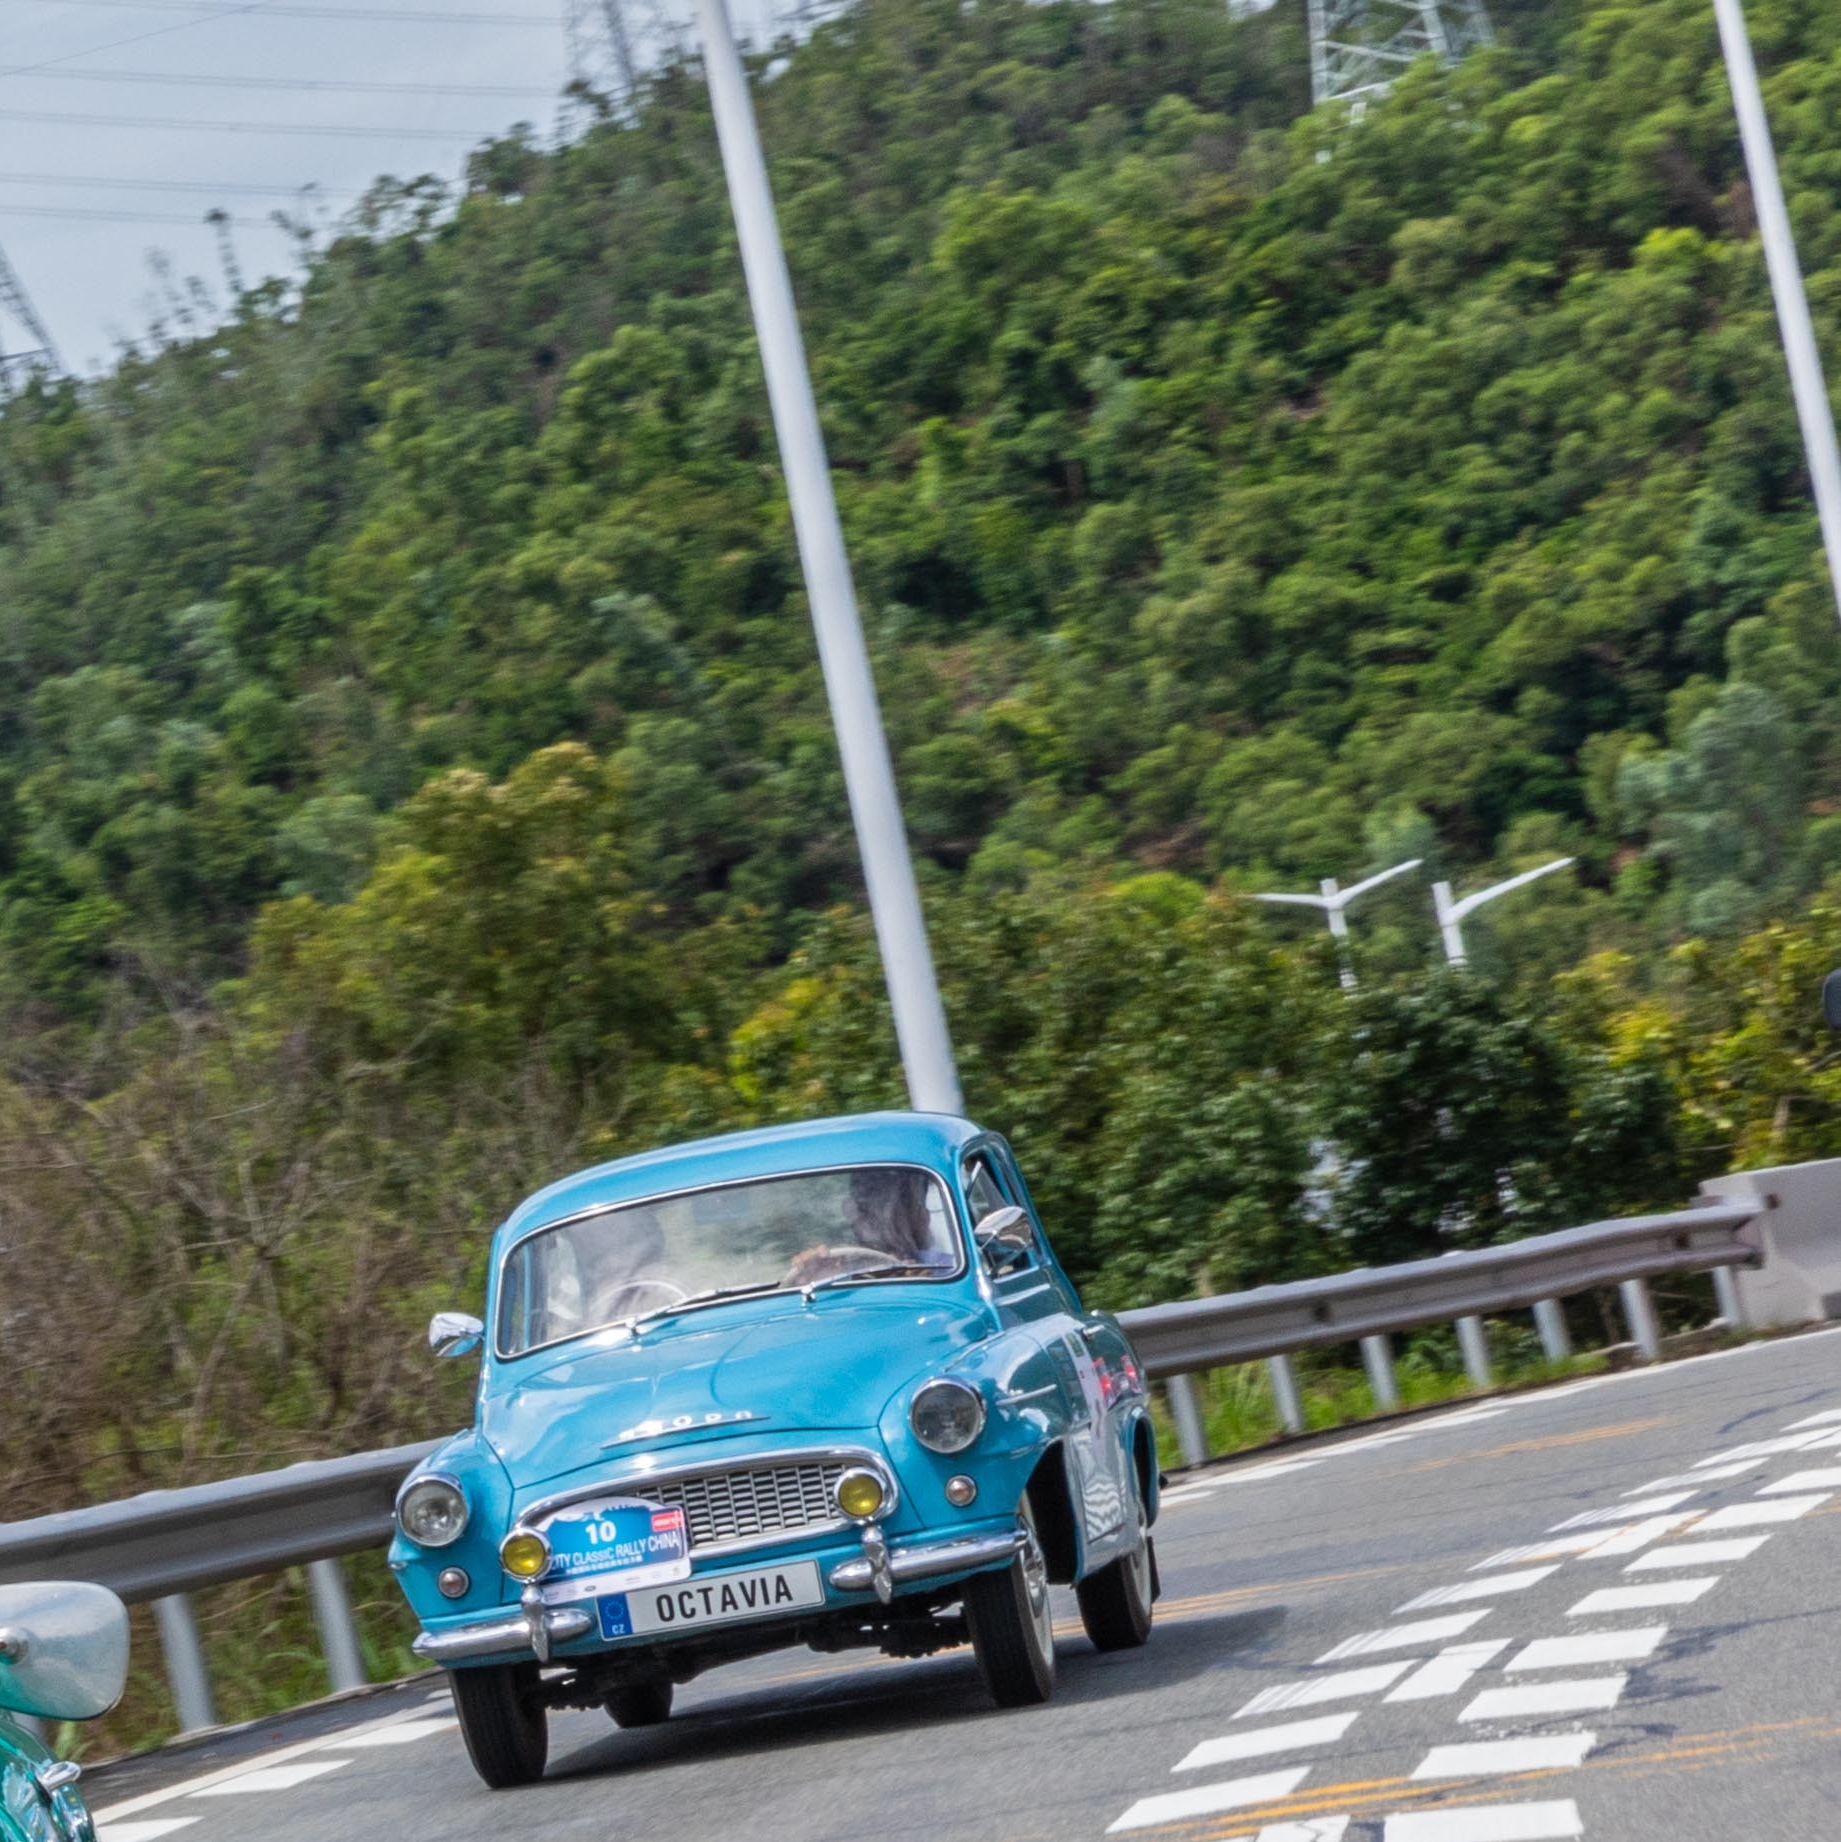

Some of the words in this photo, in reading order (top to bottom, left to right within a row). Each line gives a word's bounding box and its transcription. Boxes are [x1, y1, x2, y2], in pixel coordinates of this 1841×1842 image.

[573, 1548, 614, 1566] CLASSIC
[615, 1538, 647, 1557] RALLY
[648, 1530, 679, 1552] CHINA
[585, 1521, 616, 1545] 10
[655, 1574, 793, 1622] OCTAVIA
[612, 1623, 625, 1635] CZ
